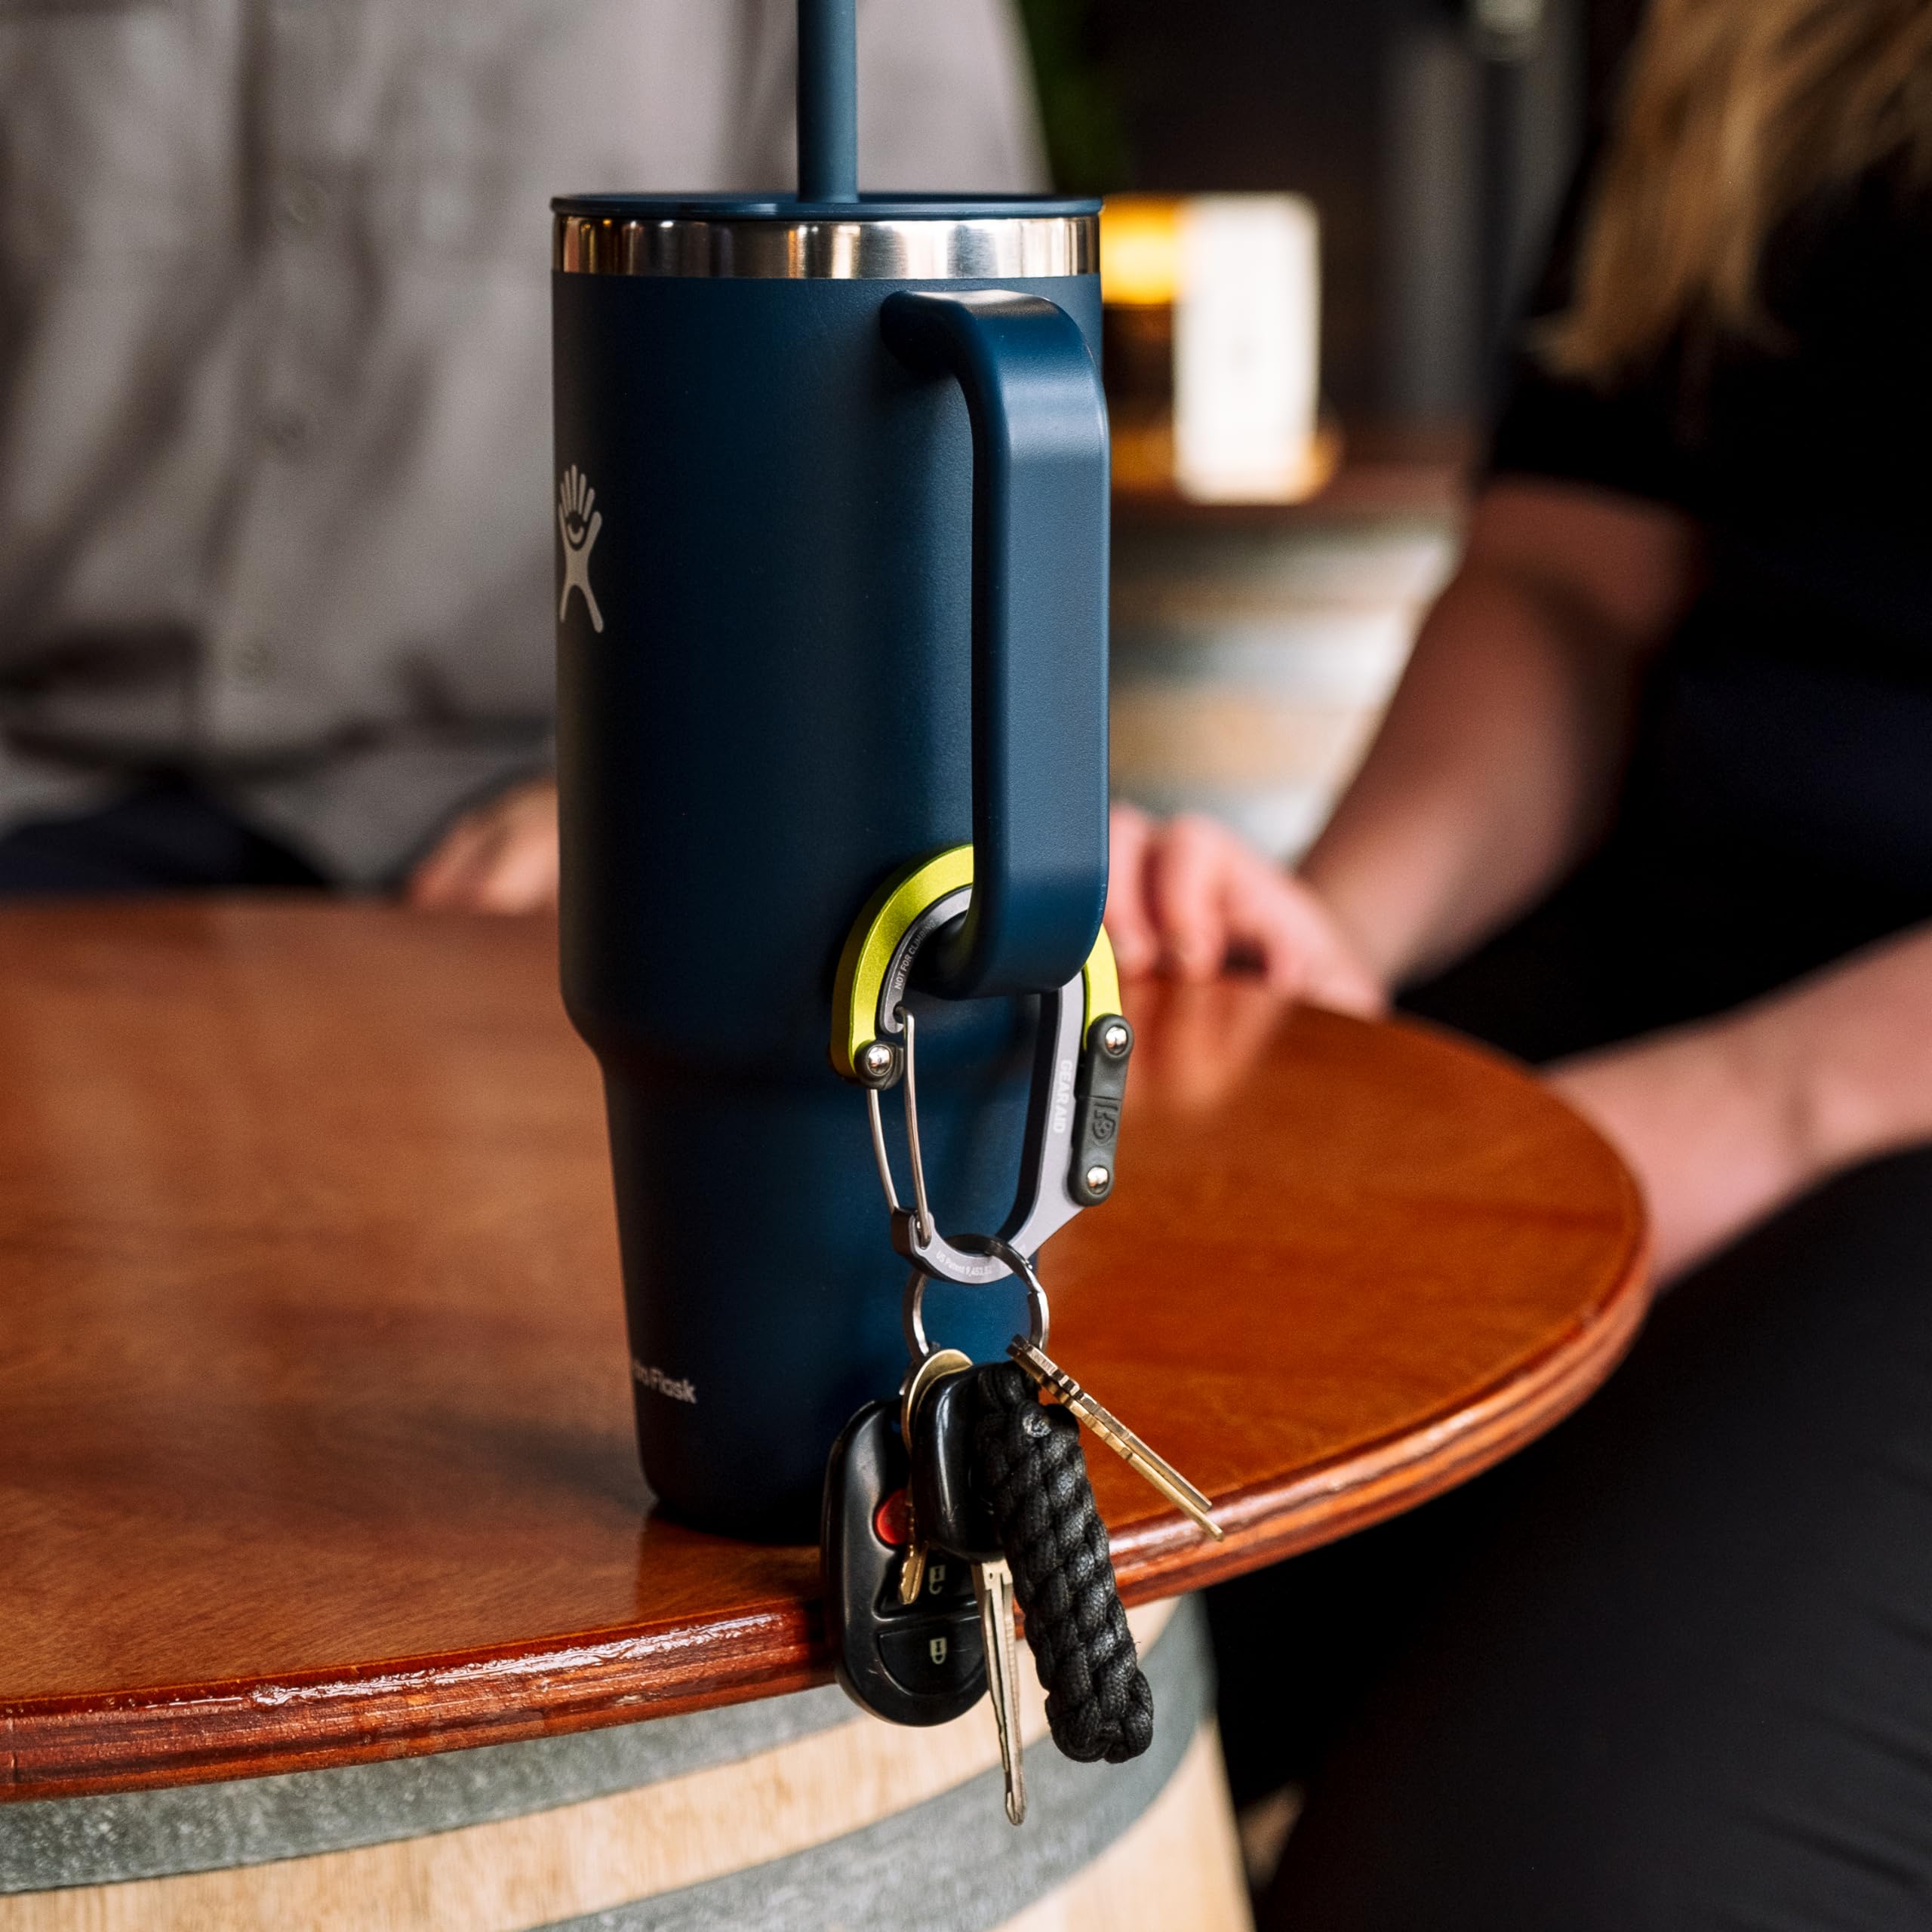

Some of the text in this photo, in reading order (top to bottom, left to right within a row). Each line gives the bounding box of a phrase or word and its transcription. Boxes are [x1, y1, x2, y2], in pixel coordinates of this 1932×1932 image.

[894, 918, 937, 990] NOT FOR CLIMBING
[1053, 1060, 1073, 1134] GEAR AID
